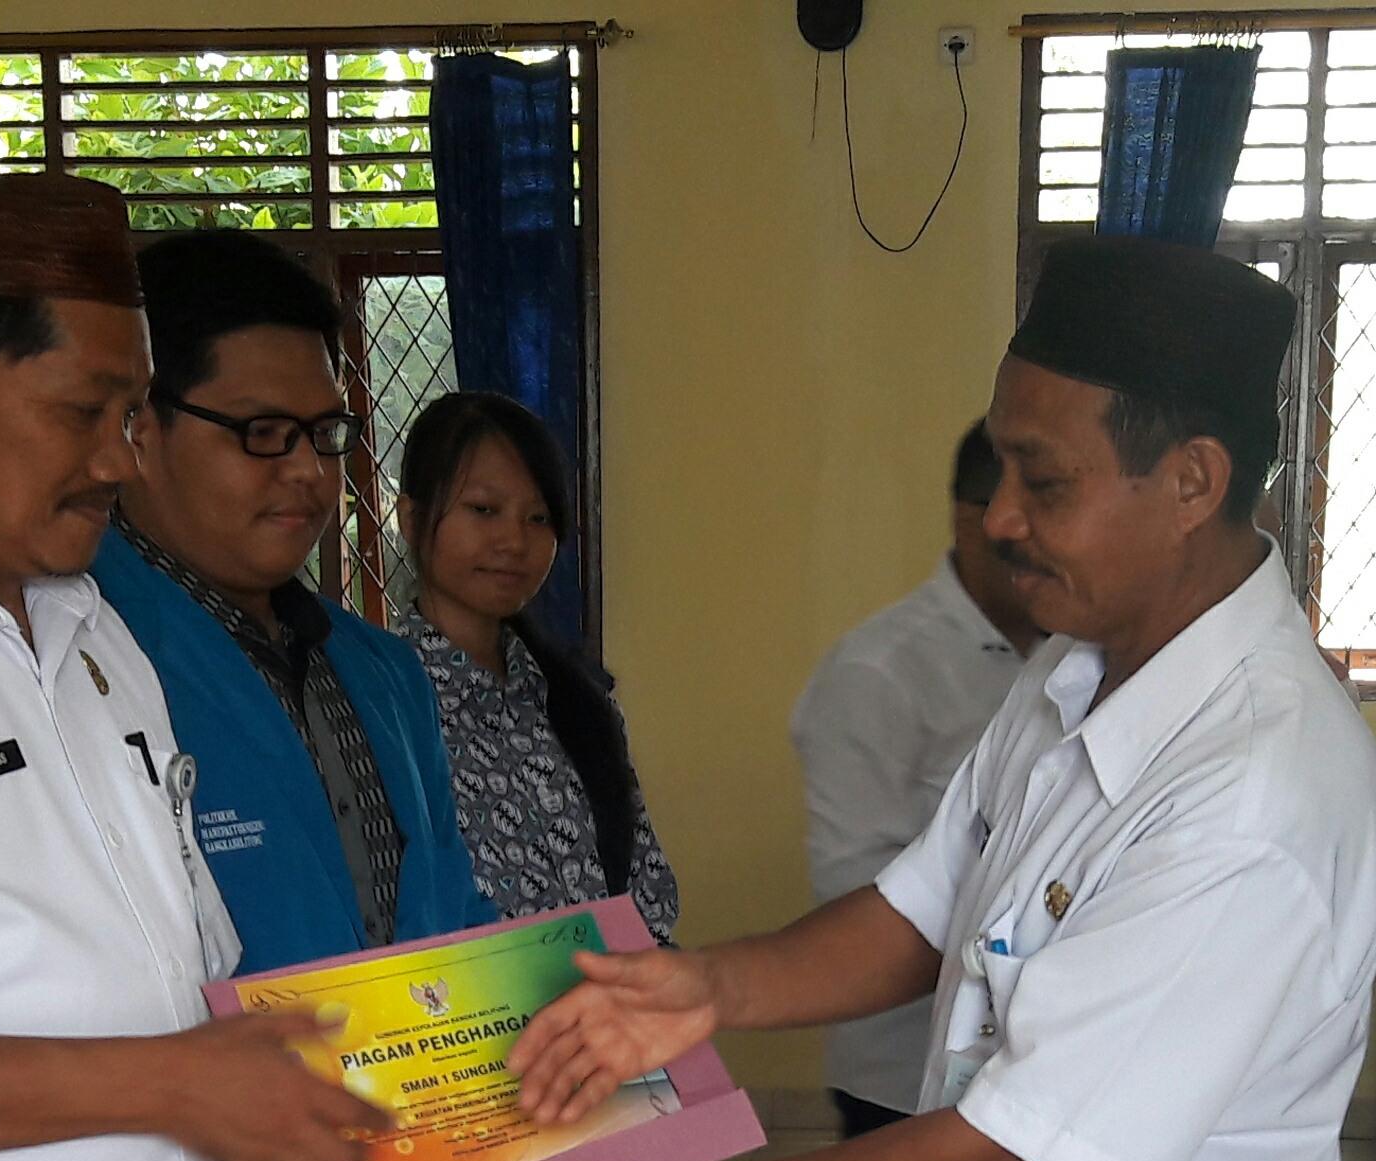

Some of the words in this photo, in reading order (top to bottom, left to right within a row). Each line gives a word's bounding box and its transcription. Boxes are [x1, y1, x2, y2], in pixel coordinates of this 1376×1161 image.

[340, 1042, 414, 1070] PIAGAM
[401, 1075, 439, 1094] SMAN
[443, 1075, 449, 1085] 1
